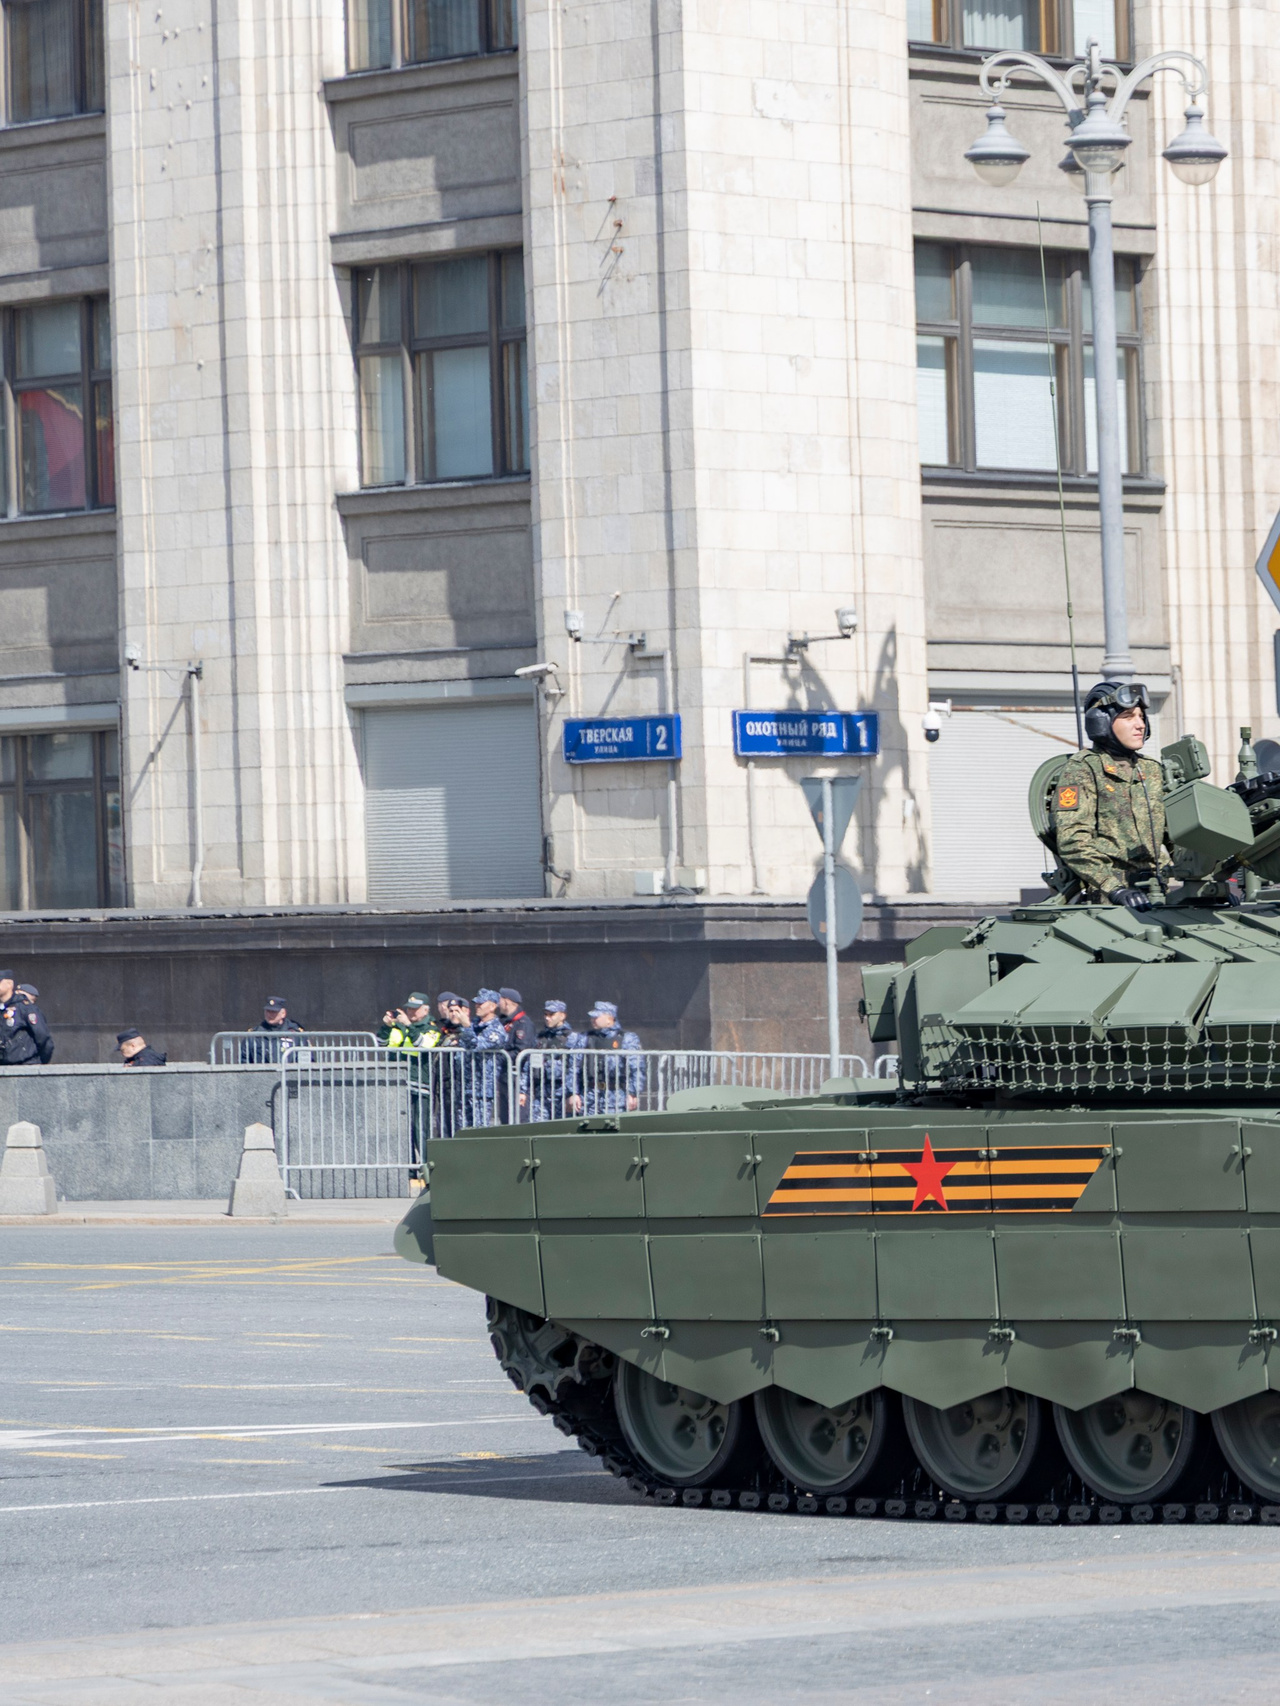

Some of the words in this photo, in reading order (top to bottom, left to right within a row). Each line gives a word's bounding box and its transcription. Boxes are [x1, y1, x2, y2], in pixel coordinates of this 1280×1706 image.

[579, 726, 634, 745] ТВЕРСКАЯ
[655, 724, 667, 751] 2
[746, 719, 808, 737] ОХОТНЫЙ
[811, 721, 838, 738] РЯД
[856, 719, 868, 748] 1
